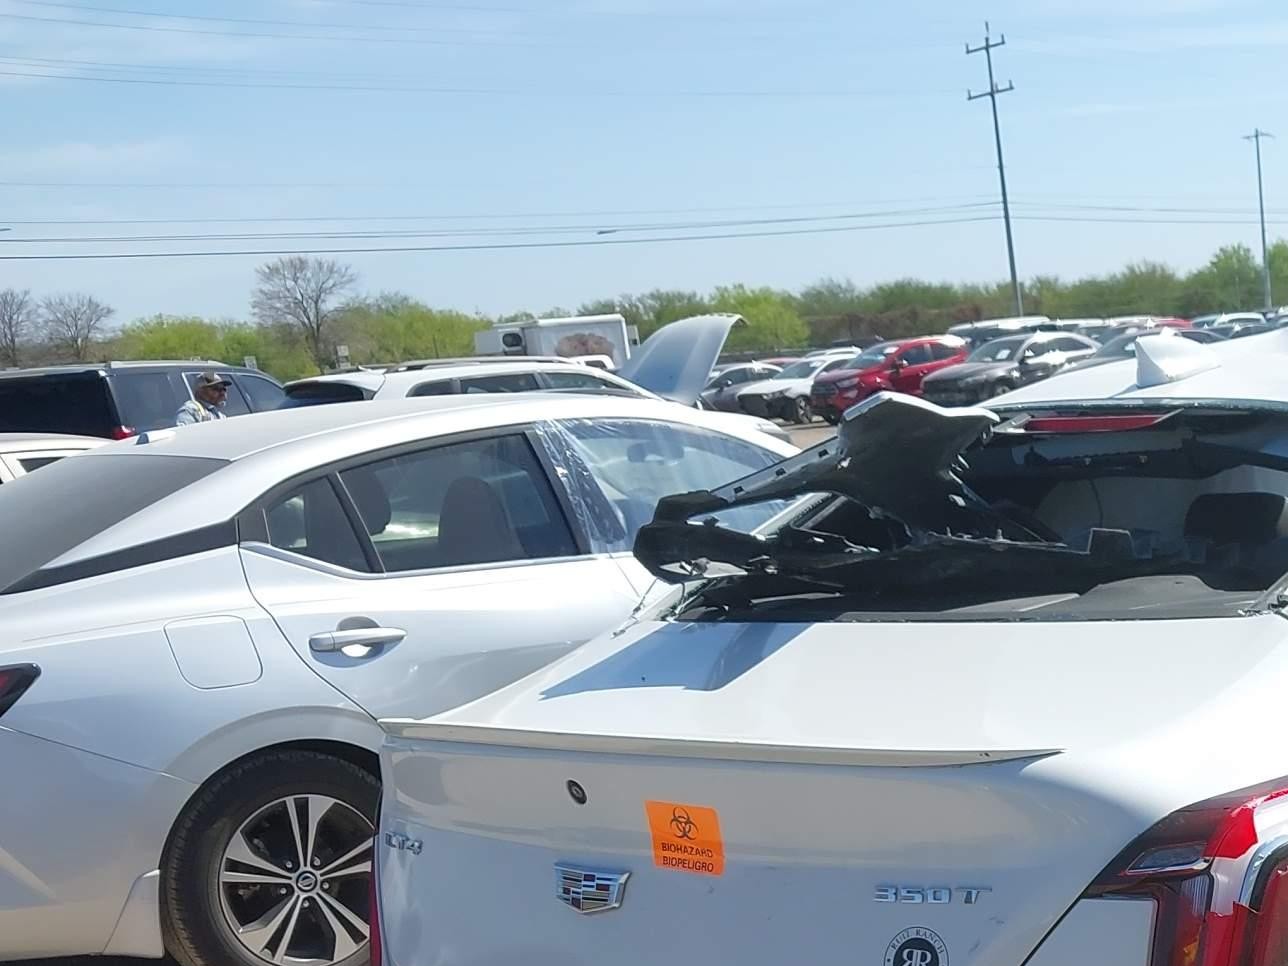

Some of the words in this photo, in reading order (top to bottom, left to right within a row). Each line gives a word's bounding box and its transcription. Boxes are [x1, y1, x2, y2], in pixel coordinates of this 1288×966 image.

[661, 842, 714, 858] BIOHAZARD
[662, 855, 715, 873] BIOPELIGRO
[915, 929, 945, 955] RANCH
